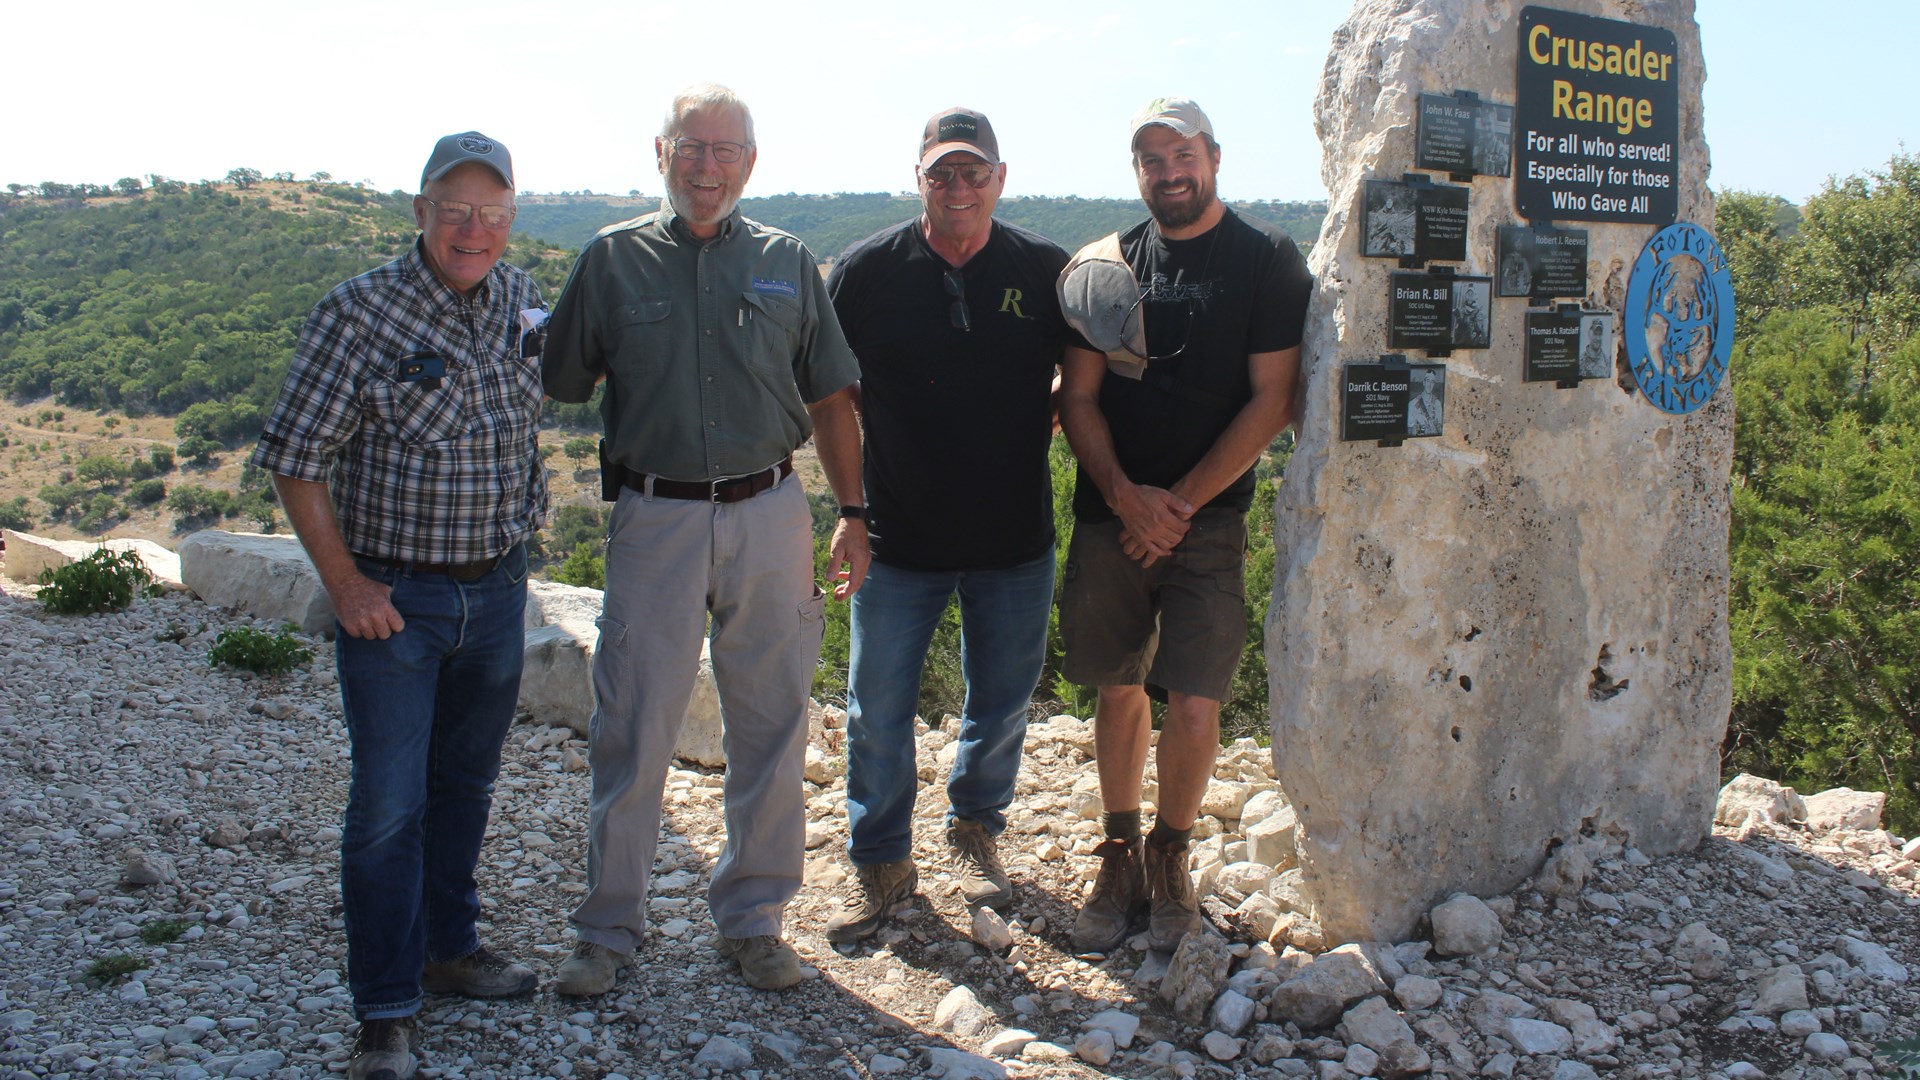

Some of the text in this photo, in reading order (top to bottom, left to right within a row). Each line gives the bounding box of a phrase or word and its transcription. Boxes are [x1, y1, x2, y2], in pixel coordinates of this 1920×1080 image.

[1529, 24, 1673, 81] Crusader
[1425, 104, 1470, 119] John W. Faas
[1553, 80, 1652, 135] Range
[1527, 130, 1671, 163] For all who served!
[1528, 161, 1670, 188] Especially for those
[1436, 206, 1449, 215] Kyle
[1552, 191, 1648, 213] Who Gave All
[1535, 235, 1557, 245] Robert
[1564, 236, 1586, 246] Reeves
[1396, 287, 1448, 300] Brian R. Bill
[998, 288, 1030, 318] R
[1530, 327, 1552, 336] Thomas
[1348, 381, 1408, 392] Darrik C. Benson
[1635, 354, 1725, 411] RANCH
[1377, 393, 1390, 402] Navy
